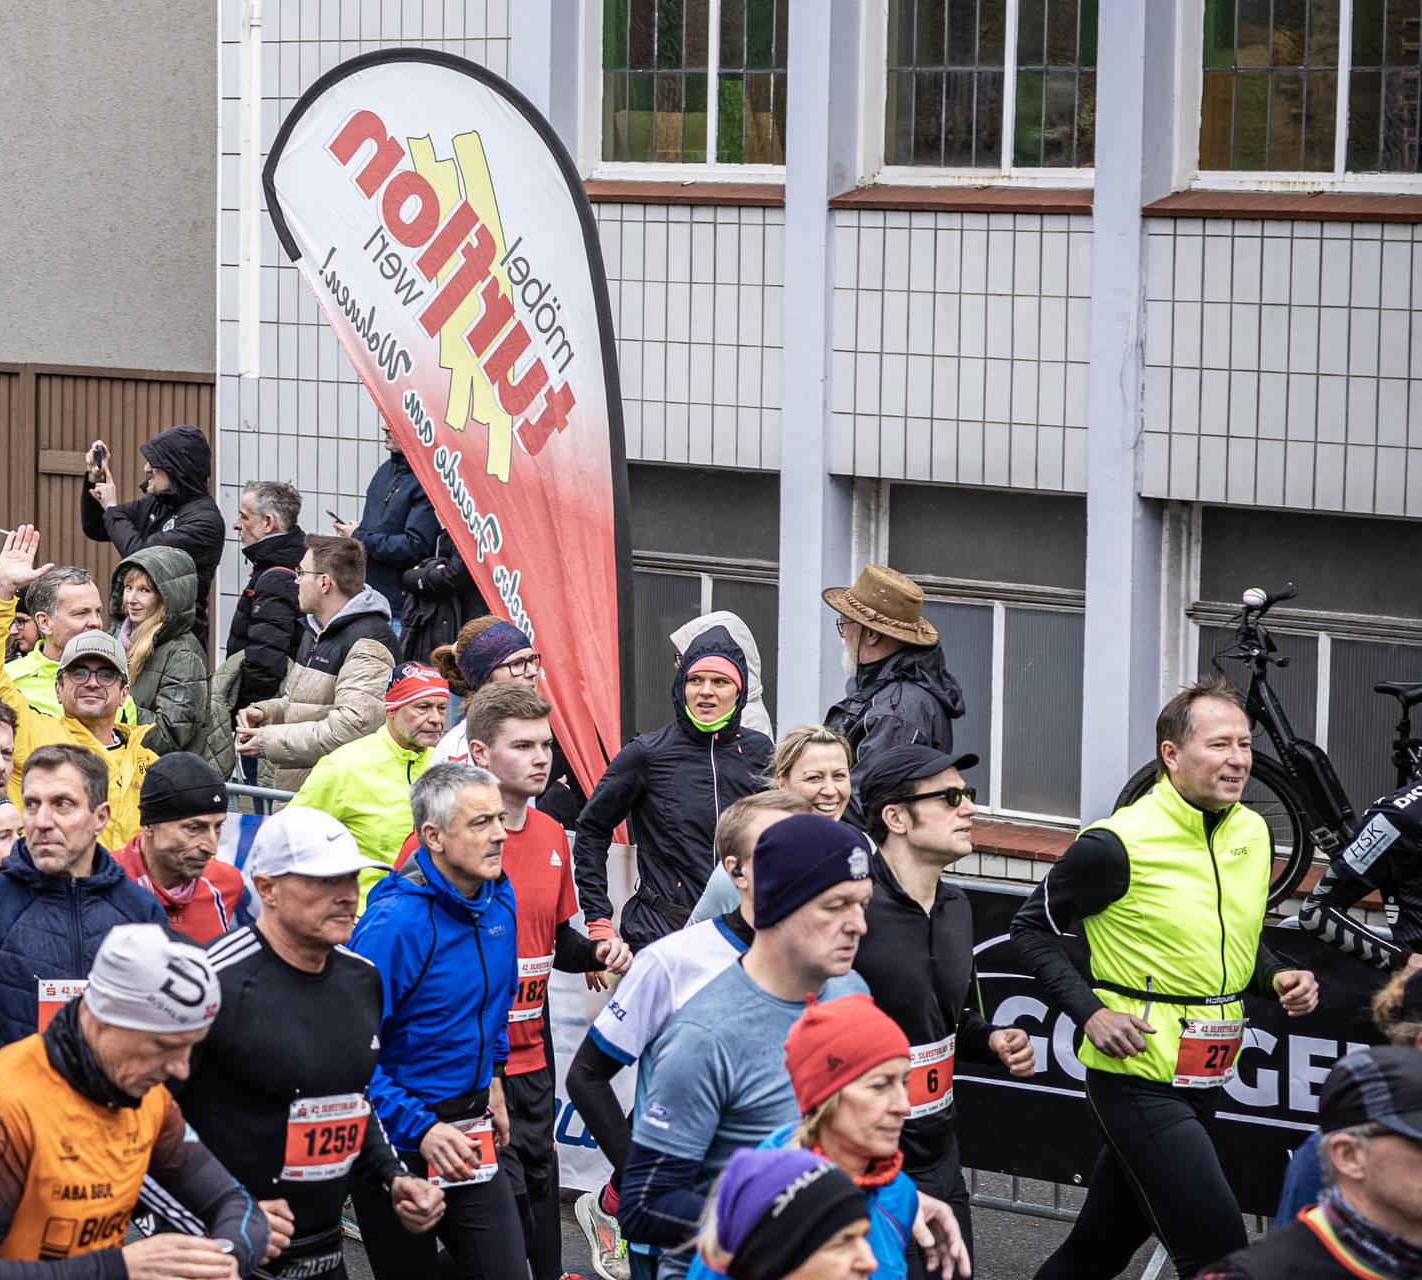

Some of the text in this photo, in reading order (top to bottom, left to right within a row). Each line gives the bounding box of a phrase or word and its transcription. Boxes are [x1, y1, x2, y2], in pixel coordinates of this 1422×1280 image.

[1350, 822, 1384, 859] HSK
[1204, 1044, 1231, 1069] 27
[927, 1068, 938, 1094] 6
[304, 1123, 359, 1157] 1259
